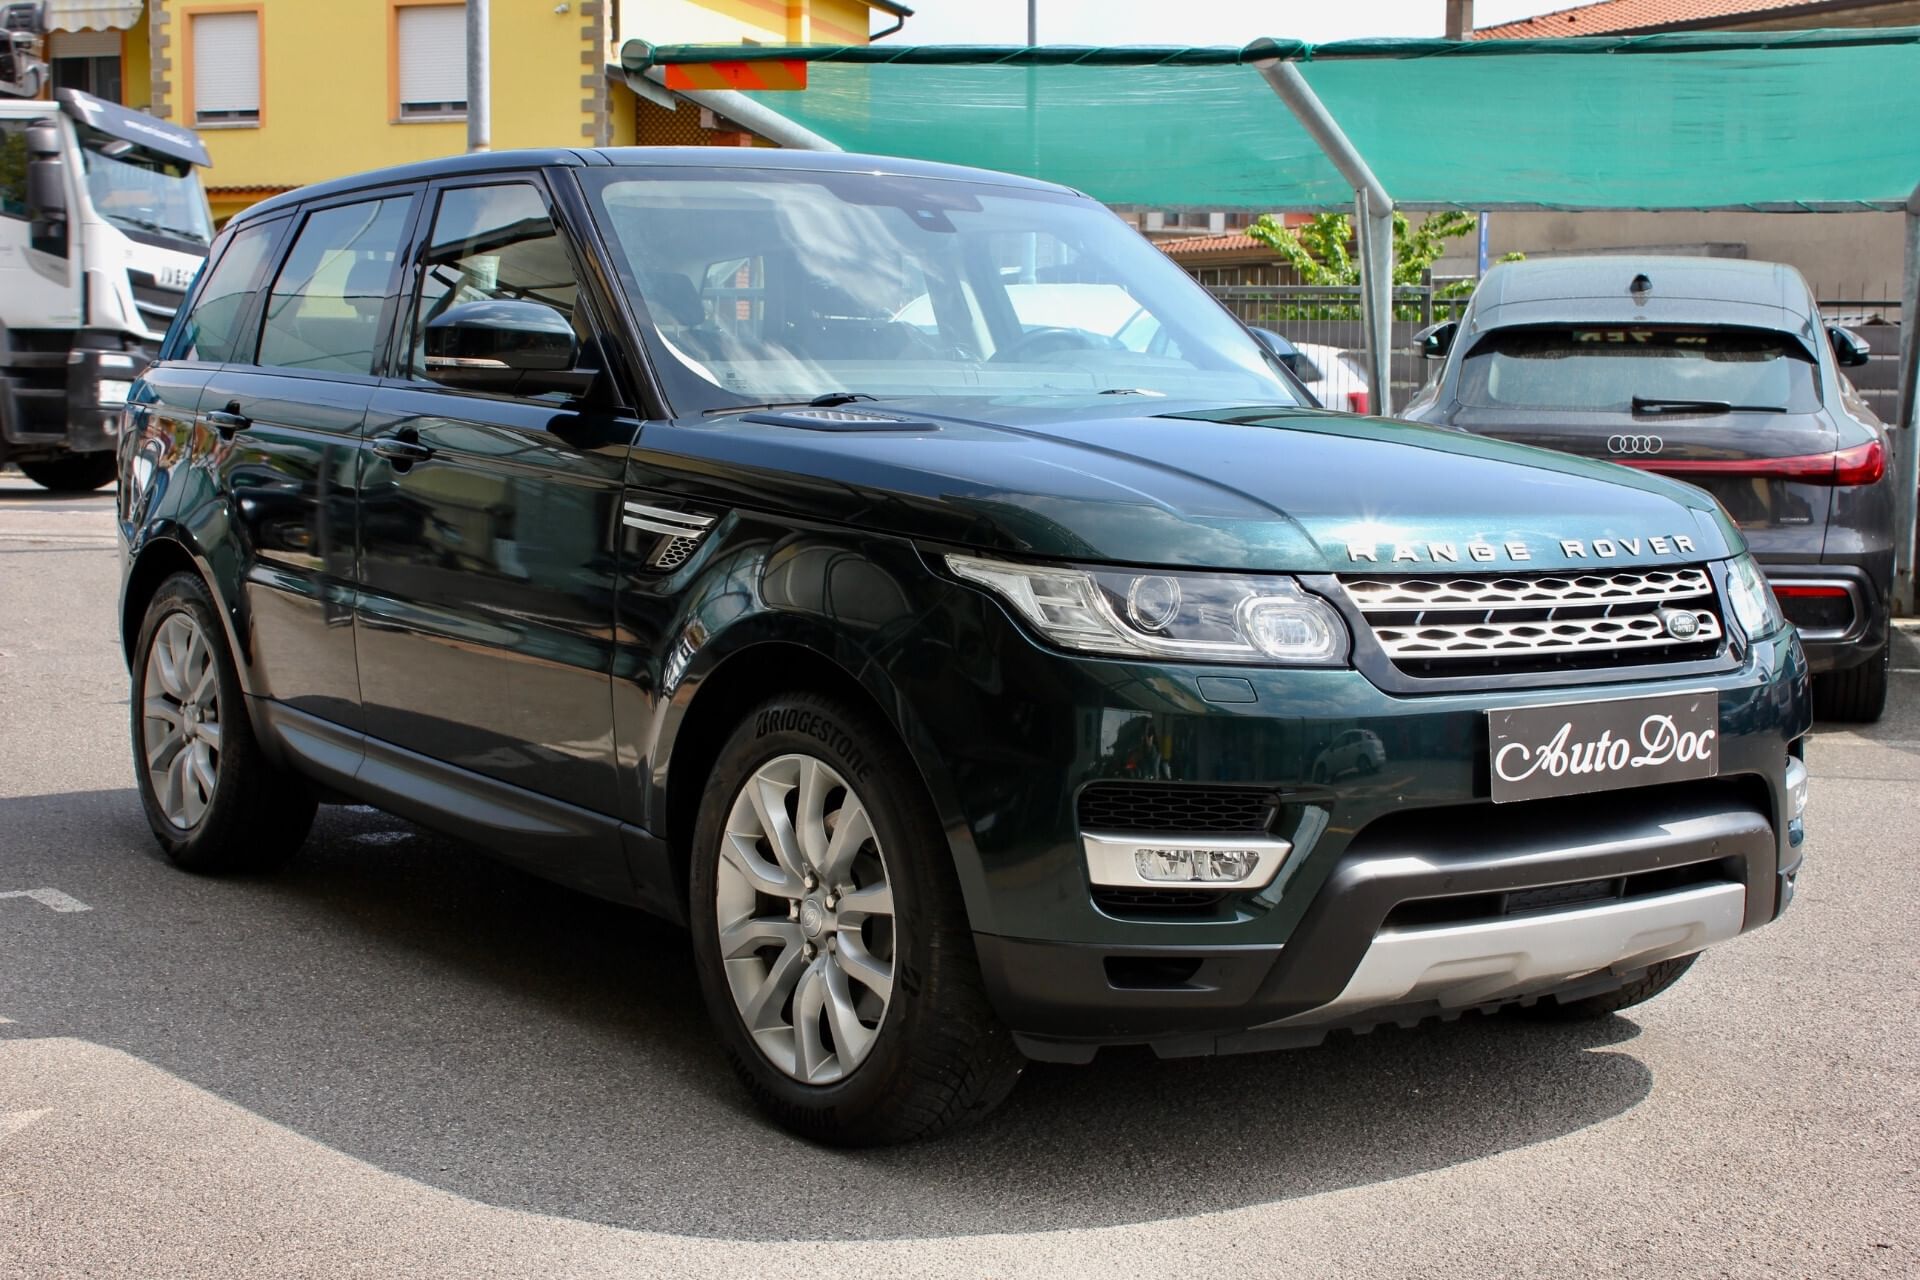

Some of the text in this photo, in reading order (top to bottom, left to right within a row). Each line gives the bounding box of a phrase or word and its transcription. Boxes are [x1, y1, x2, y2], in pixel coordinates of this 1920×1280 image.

[1346, 534, 1696, 563] RANGE ROVER
[755, 707, 873, 784] BRIDGESTONE
